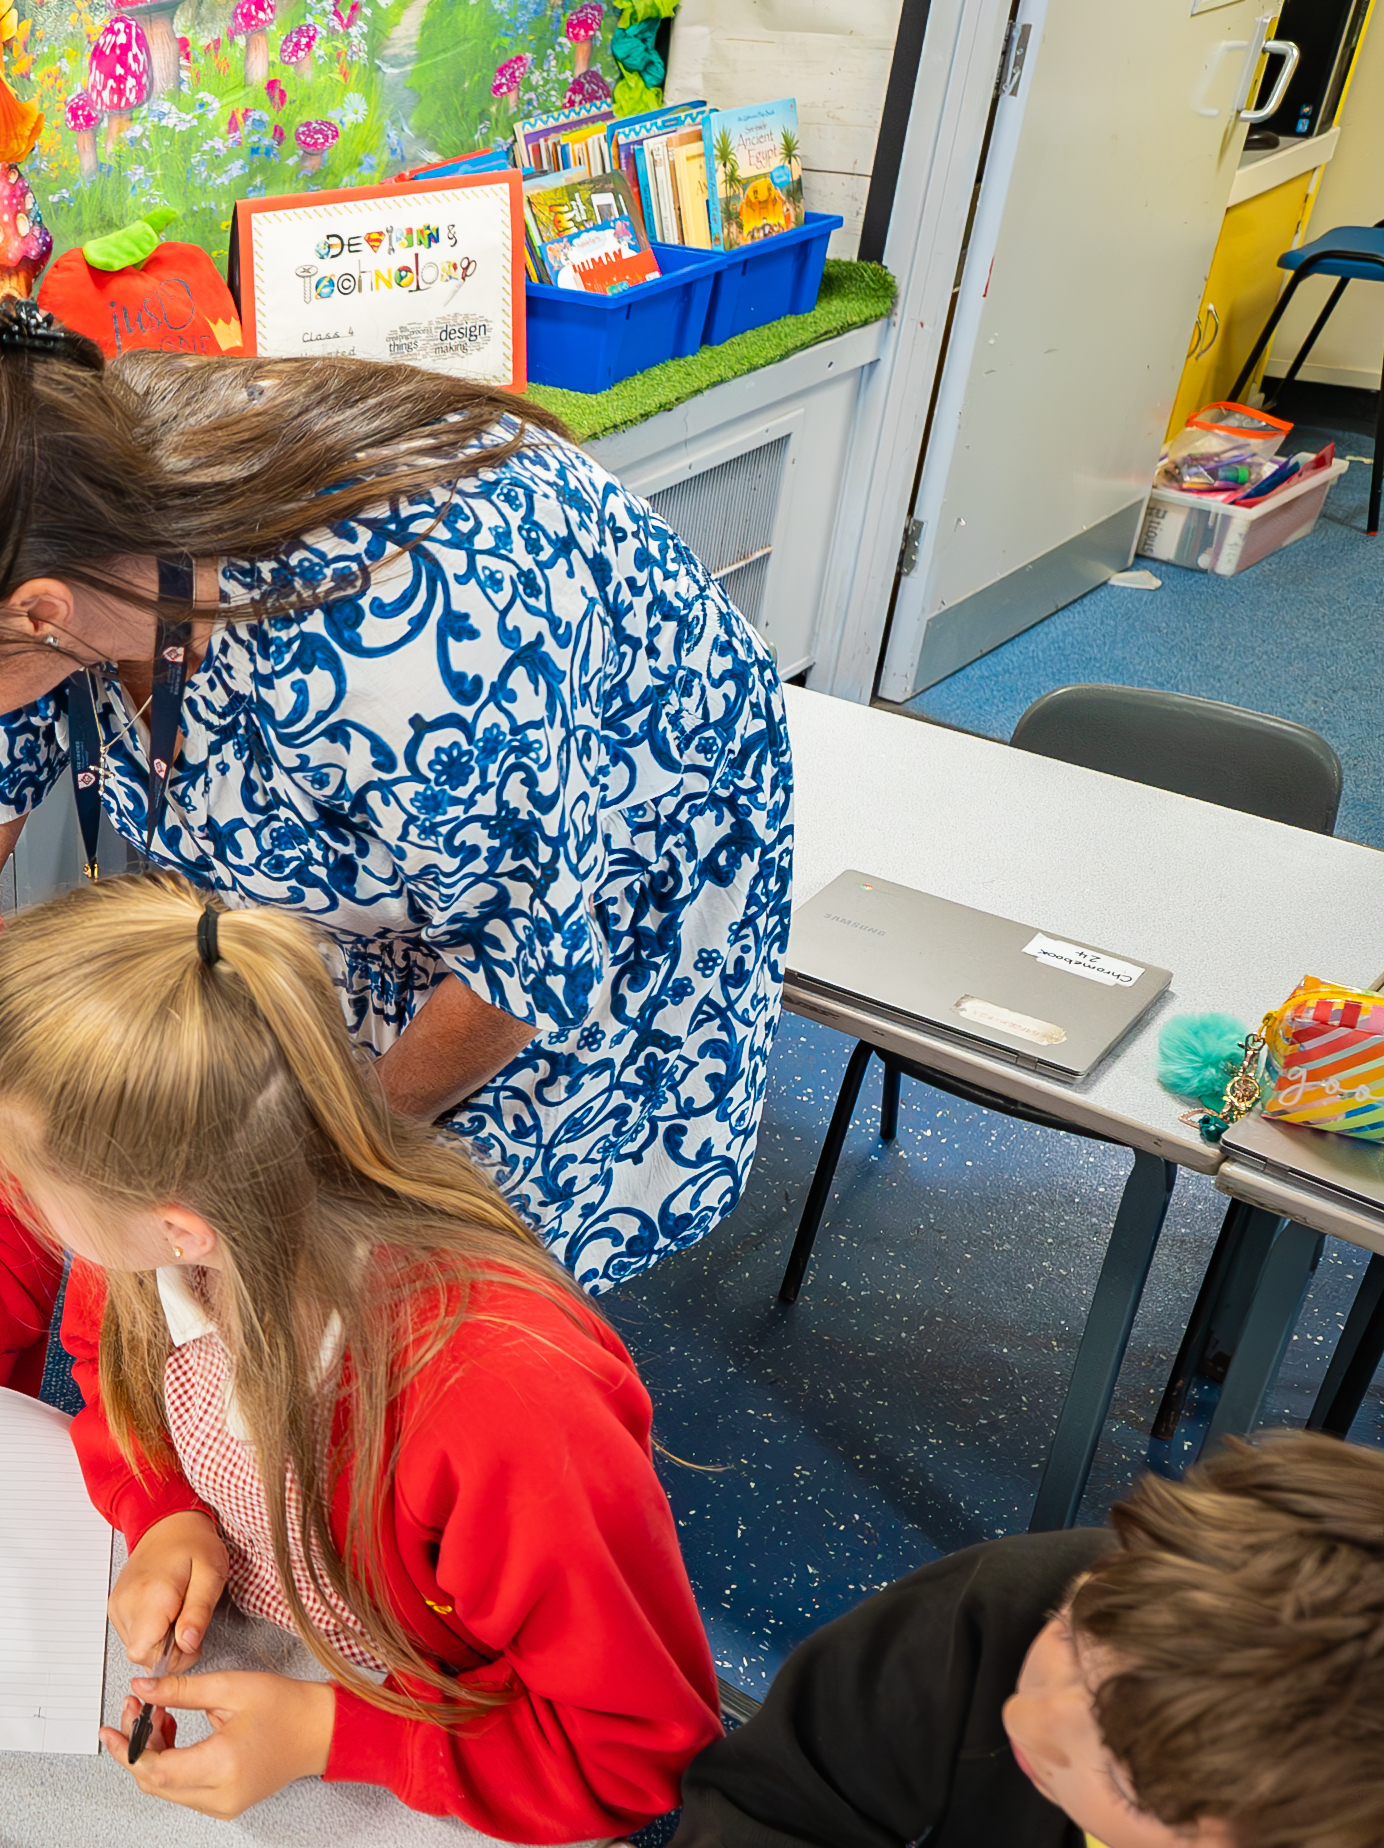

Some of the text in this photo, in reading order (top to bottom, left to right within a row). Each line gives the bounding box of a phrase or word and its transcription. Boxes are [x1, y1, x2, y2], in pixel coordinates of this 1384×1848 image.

[737, 130, 774, 150] Ancient
[748, 144, 777, 170] Egypt
[439, 321, 486, 341] design
[388, 340, 418, 353] things
[434, 342, 468, 355] making
[1037, 947, 1132, 983] Chromebook
[1074, 950, 1100, 963] 24
